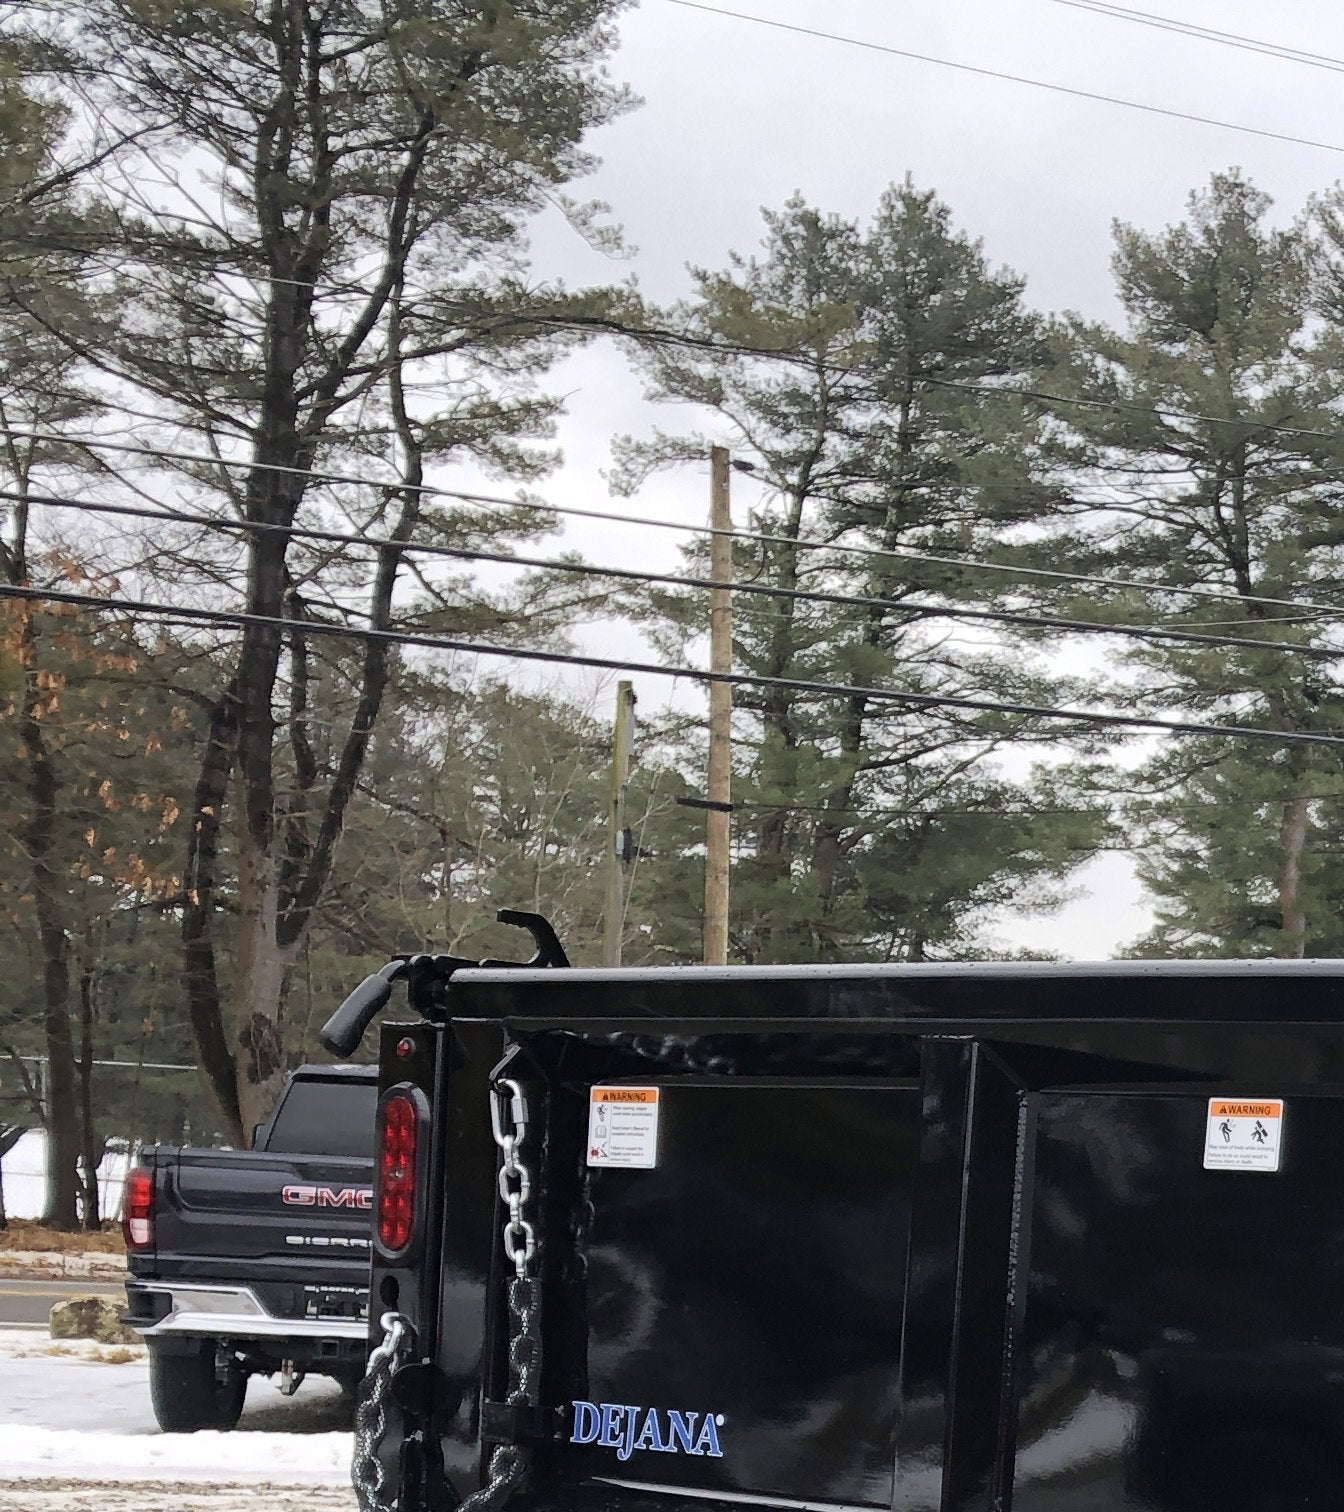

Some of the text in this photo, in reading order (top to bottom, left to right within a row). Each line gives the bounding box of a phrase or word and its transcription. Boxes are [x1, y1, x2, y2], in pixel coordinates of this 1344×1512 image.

[610, 1092, 646, 1102] WARNING
[1228, 1105, 1271, 1116] WARNING
[282, 1185, 374, 1209] GMC
[286, 1235, 373, 1248] SIERR
[570, 1401, 723, 1461] DEJANA
